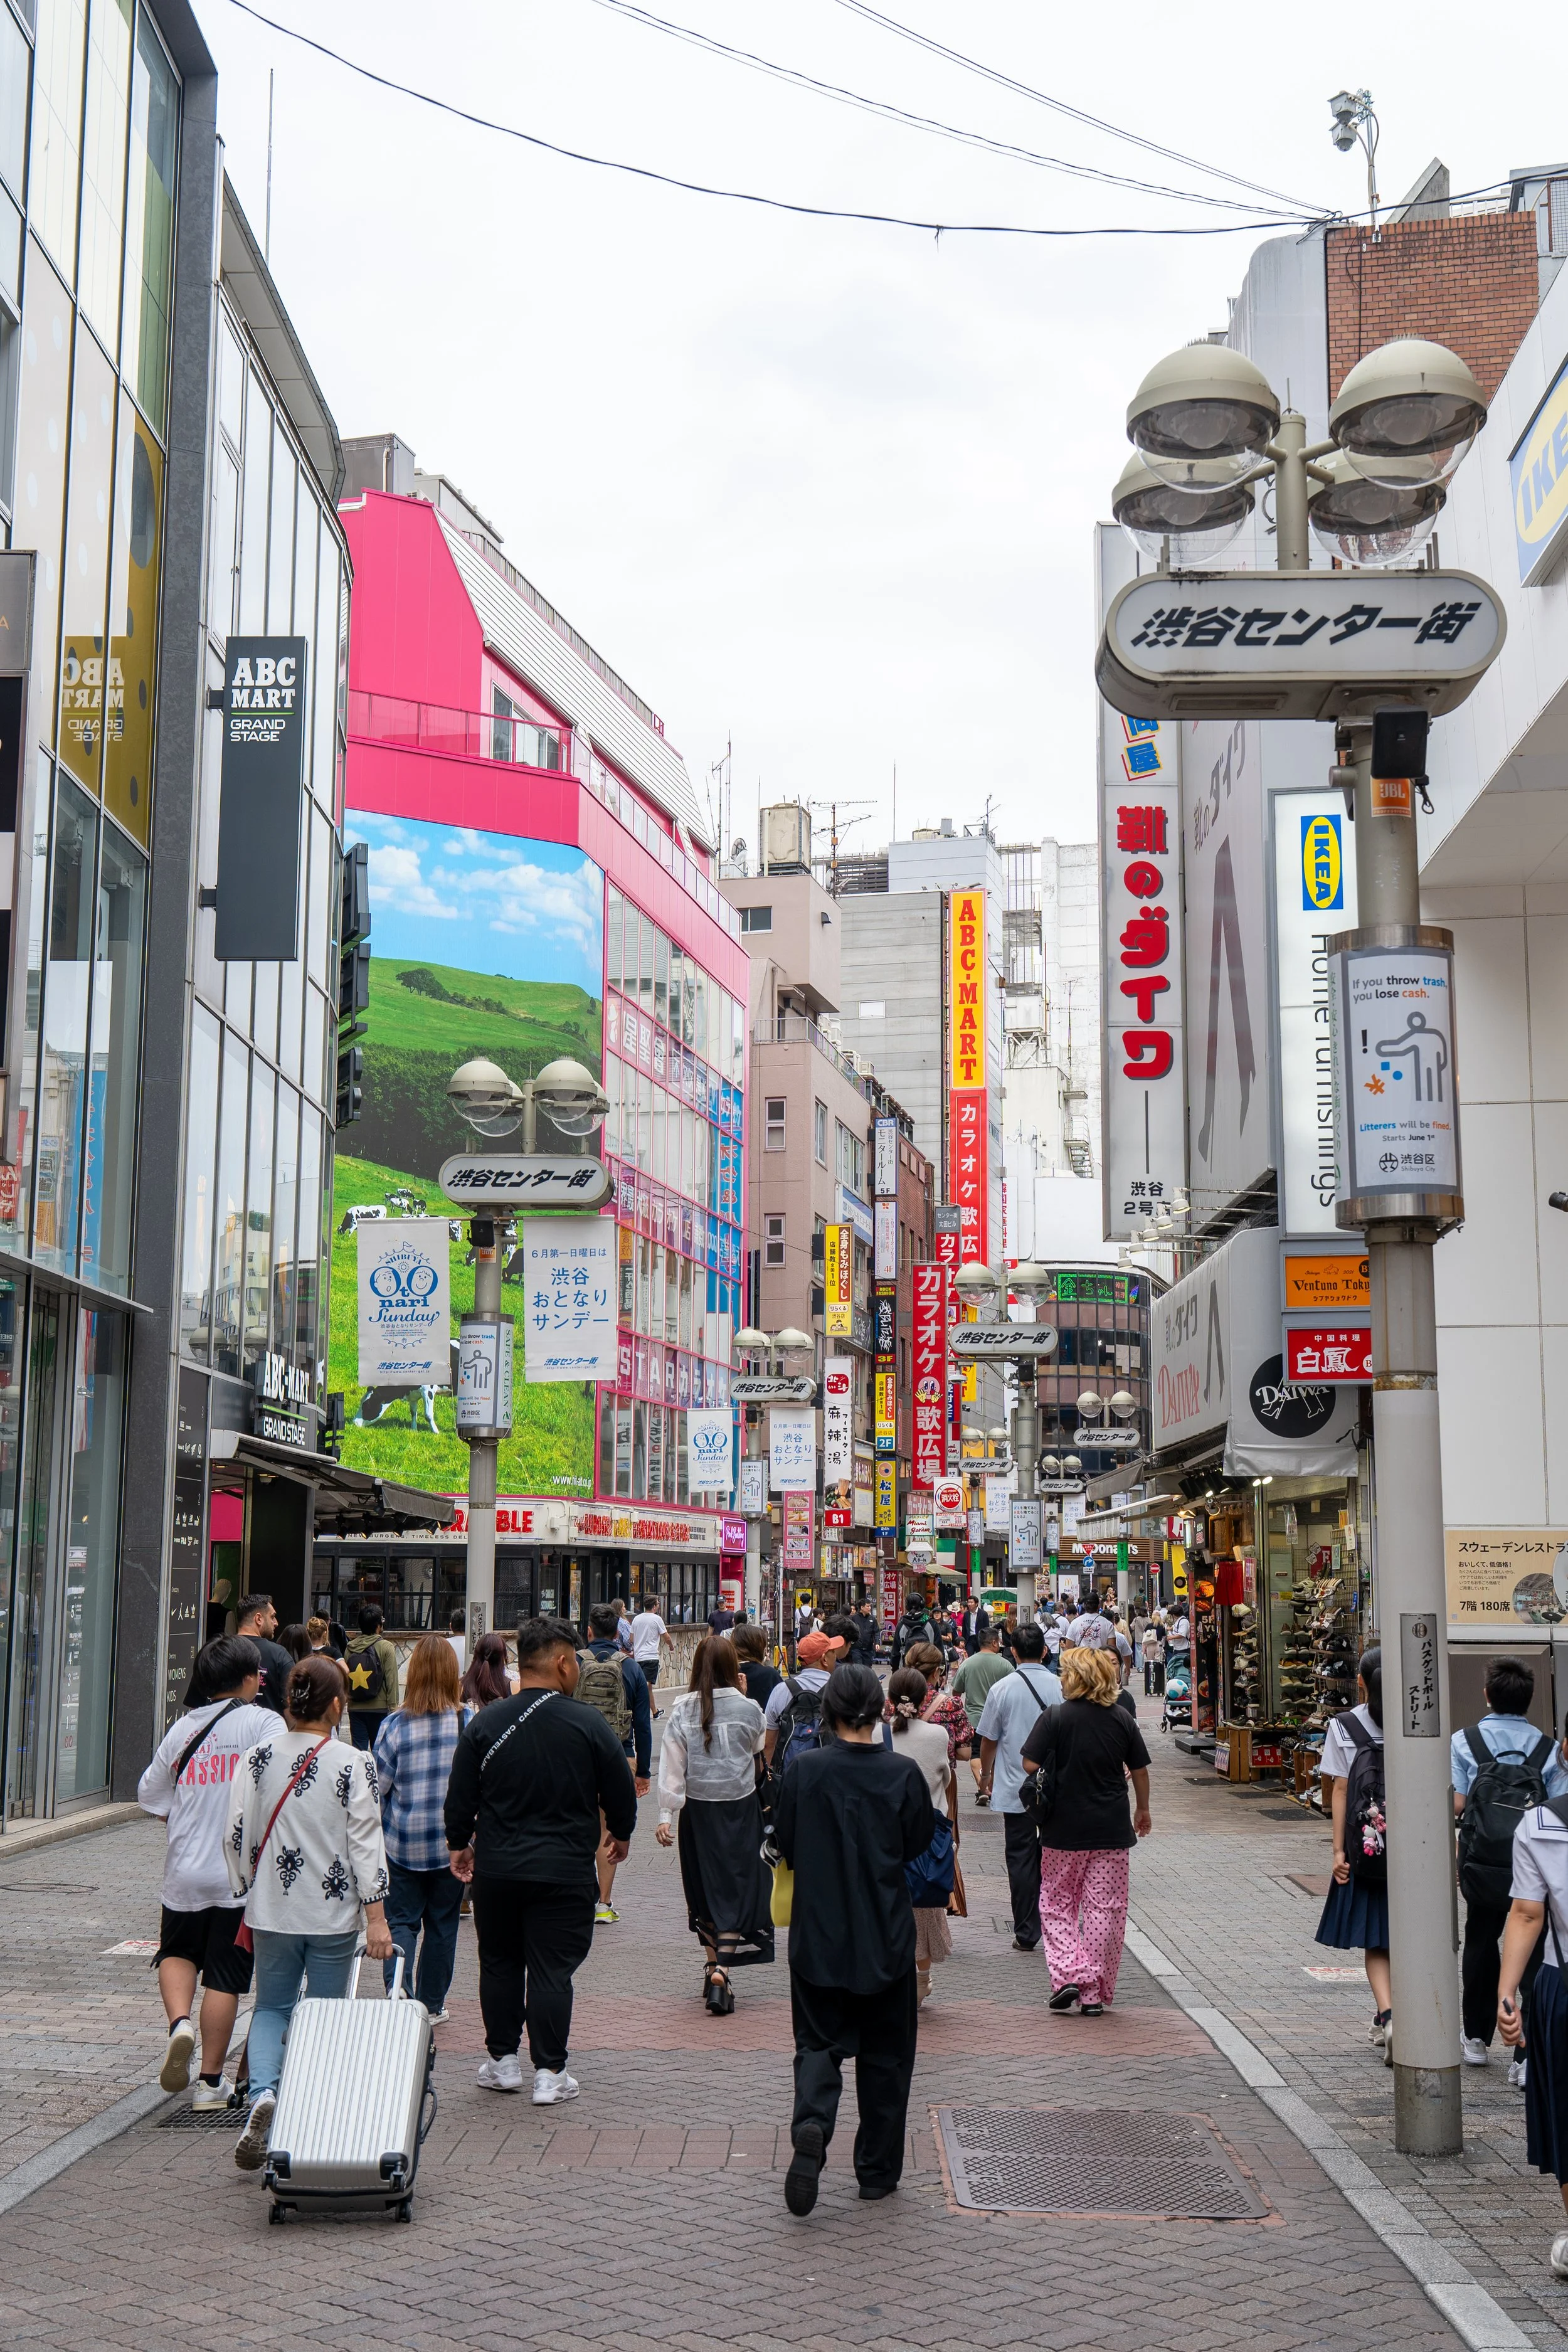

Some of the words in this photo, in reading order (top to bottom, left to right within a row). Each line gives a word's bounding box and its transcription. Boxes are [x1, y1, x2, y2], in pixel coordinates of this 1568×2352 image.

[1131, 601, 1482, 648] 渋谷センター街
[232, 657, 296, 686] ABC
[231, 689, 295, 708] MART
[230, 719, 286, 730] GRAND
[230, 731, 280, 741] STAGE
[1379, 783, 1406, 798] JBL
[1313, 825, 1332, 902] IKEA
[1117, 806, 1173, 1080] 靴のダイワ
[1353, 978, 1360, 989] If
[1362, 978, 1382, 991] you
[1386, 976, 1419, 987] throw
[1422, 976, 1448, 988] trash,
[1353, 992, 1372, 1004] you
[1375, 988, 1399, 1000] lose
[1402, 988, 1429, 999] cash.
[1360, 1121, 1396, 1132] Litterers
[1399, 1120, 1417, 1129] will
[1419, 1120, 1431, 1129] be
[1433, 1121, 1451, 1130] fined.
[1382, 1134, 1406, 1142] Starts
[877, 1129, 886, 1185] モニタールーム
[1401, 1153, 1435, 1165] 渋谷区
[447, 1168, 596, 1189] 渋谷センター街
[1131, 1182, 1163, 1197] 渋谷
[385, 1254, 422, 1265] SHIBUYA
[532, 1248, 607, 1258] 6月第一日曜日は
[840, 1229, 849, 1300] 全身もみほぐし
[551, 1267, 590, 1286] 渋谷
[1061, 1278, 1113, 1296] 金ちゃん
[1292, 1279, 1338, 1291] Ventuno
[1342, 1279, 1370, 1293] Toky
[379, 1295, 429, 1308] nari
[532, 1289, 607, 1308] おとなり
[369, 1308, 440, 1326] Sunday
[532, 1311, 609, 1331] サンデー
[917, 1267, 941, 1374] カラオケ
[955, 1330, 1049, 1345] 渋谷センター街
[377, 1361, 433, 1370] 渋谷センター街
[544, 1357, 599, 1366] 渋谷センター街
[1296, 1347, 1360, 1374] 白鳳
[263, 1353, 310, 1405] ABC-MART
[734, 1383, 807, 1393] 渋谷センター街
[1158, 1362, 1200, 1429] DAIWA
[263, 1417, 286, 1441] GRAND
[286, 1421, 305, 1446] STAGE
[783, 1433, 803, 1443] 渋谷
[827, 1406, 842, 1465] 麻辣湯
[1078, 1433, 1135, 1443] 渋谷センター街
[774, 1444, 812, 1454] おとなり
[879, 1438, 891, 1448] 2F
[916, 1406, 941, 1485] 歌広場
[693, 1453, 729, 1462] Sunday
[774, 1456, 813, 1465] サンデー
[552, 1475, 591, 1489] www.hit-ad.co.jp
[879, 1480, 893, 1506] 松屋
[941, 1493, 960, 1503] 消火栓
[832, 1513, 844, 1524] B1
[1458, 1542, 1568, 1553] スウェーデンレストラ
[1459, 1601, 1477, 1611] 7階
[1480, 1601, 1510, 1611] 180席
[168, 1667, 186, 1681] WOMENS
[1421, 1639, 1434, 1711] バスケットボール
[167, 1690, 176, 1702] KIDS
[1409, 1685, 1420, 1730] ストリート
[481, 1725, 516, 1771] CASTELBAJAC
